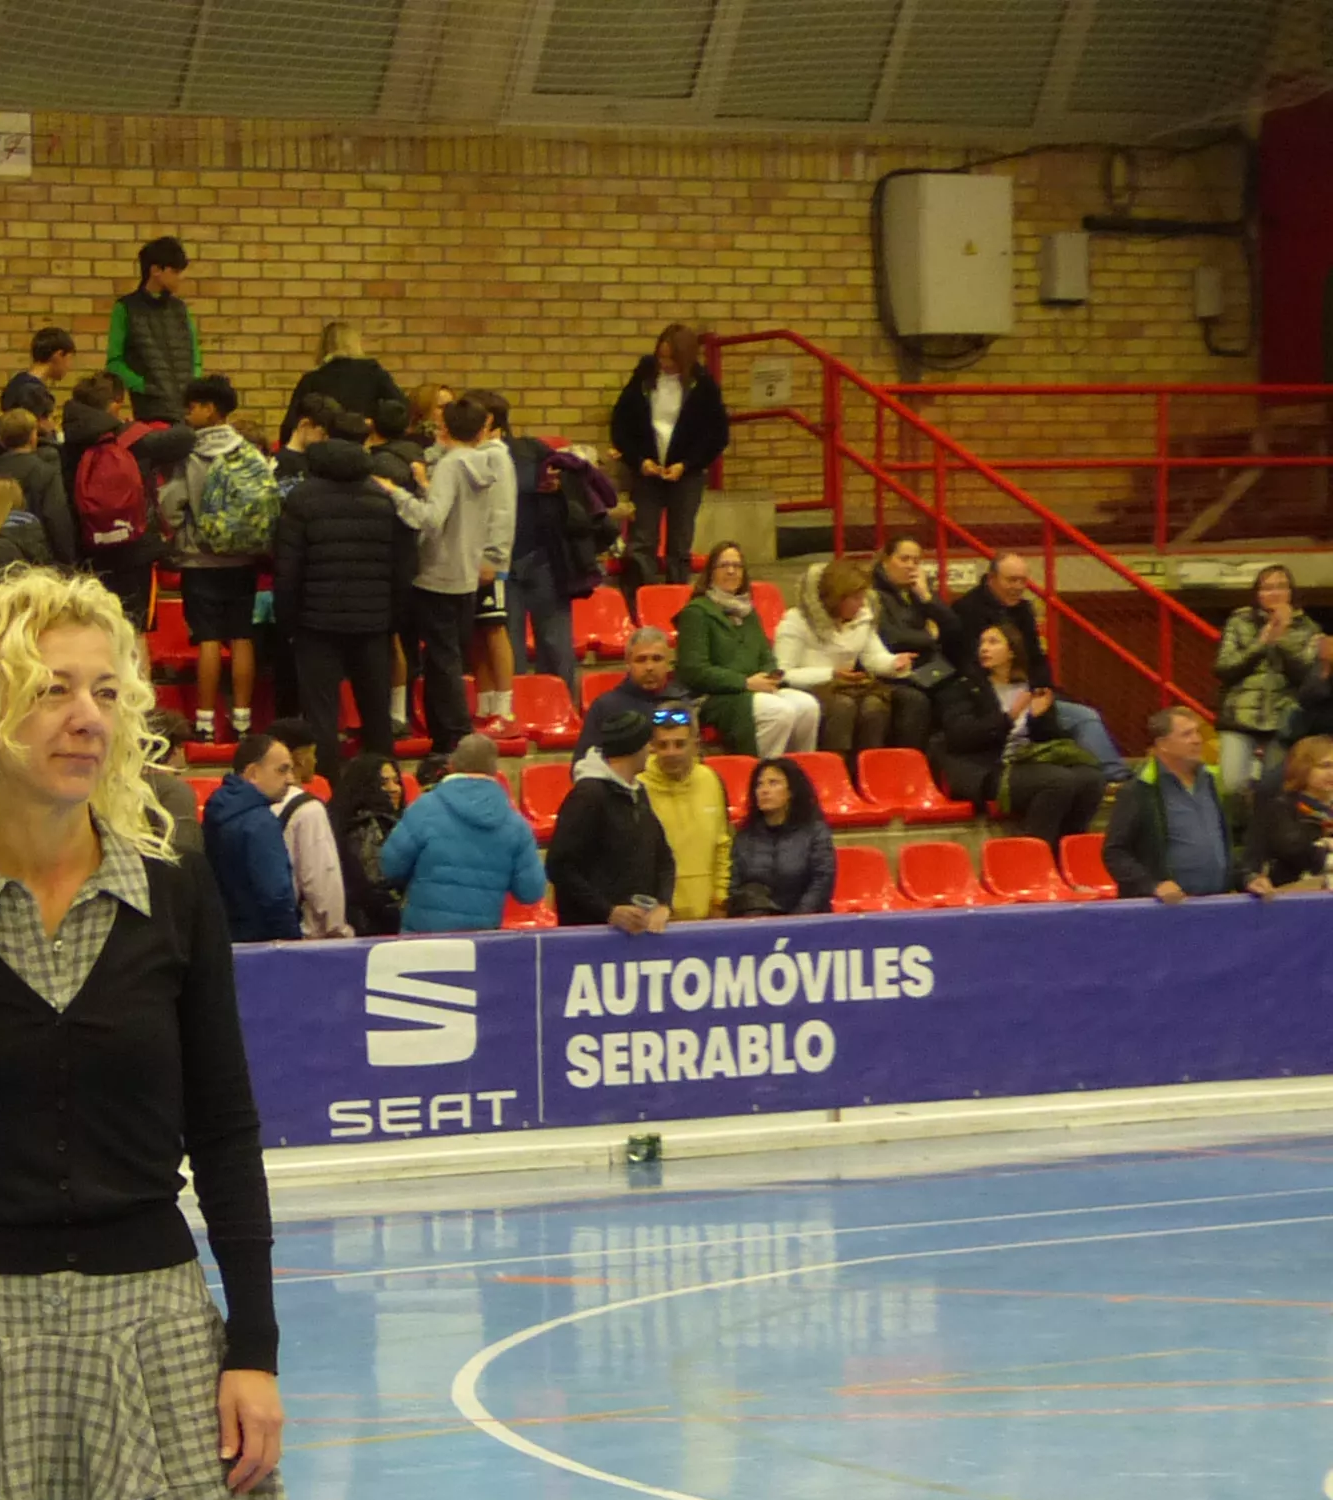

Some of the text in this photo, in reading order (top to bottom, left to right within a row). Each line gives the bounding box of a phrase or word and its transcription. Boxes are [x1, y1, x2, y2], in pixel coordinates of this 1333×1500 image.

[564, 937, 935, 1018] AUTOMÓVILES
[566, 1019, 836, 1089] SERRABLO
[329, 1090, 517, 1137] SEAT
